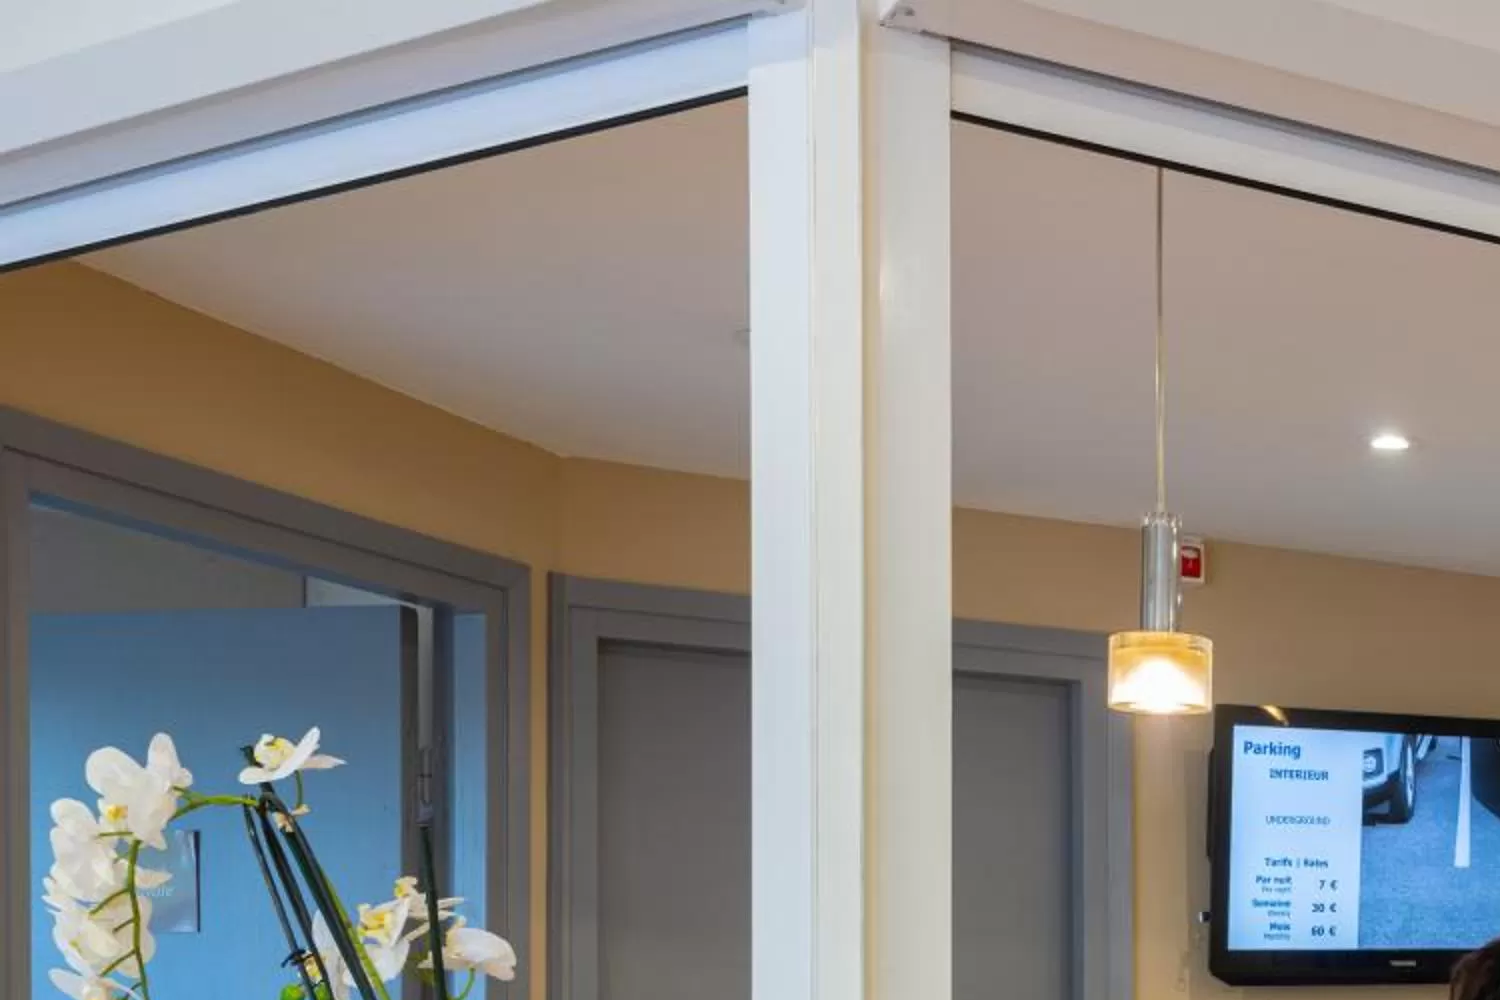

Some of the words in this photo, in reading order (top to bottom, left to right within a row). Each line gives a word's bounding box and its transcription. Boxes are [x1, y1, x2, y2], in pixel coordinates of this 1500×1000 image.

[1243, 740, 1301, 760] Parking
[1263, 856, 1293, 867] Tarifs
[1319, 879, 1326, 890] 7
[1311, 903, 1325, 913] 30
